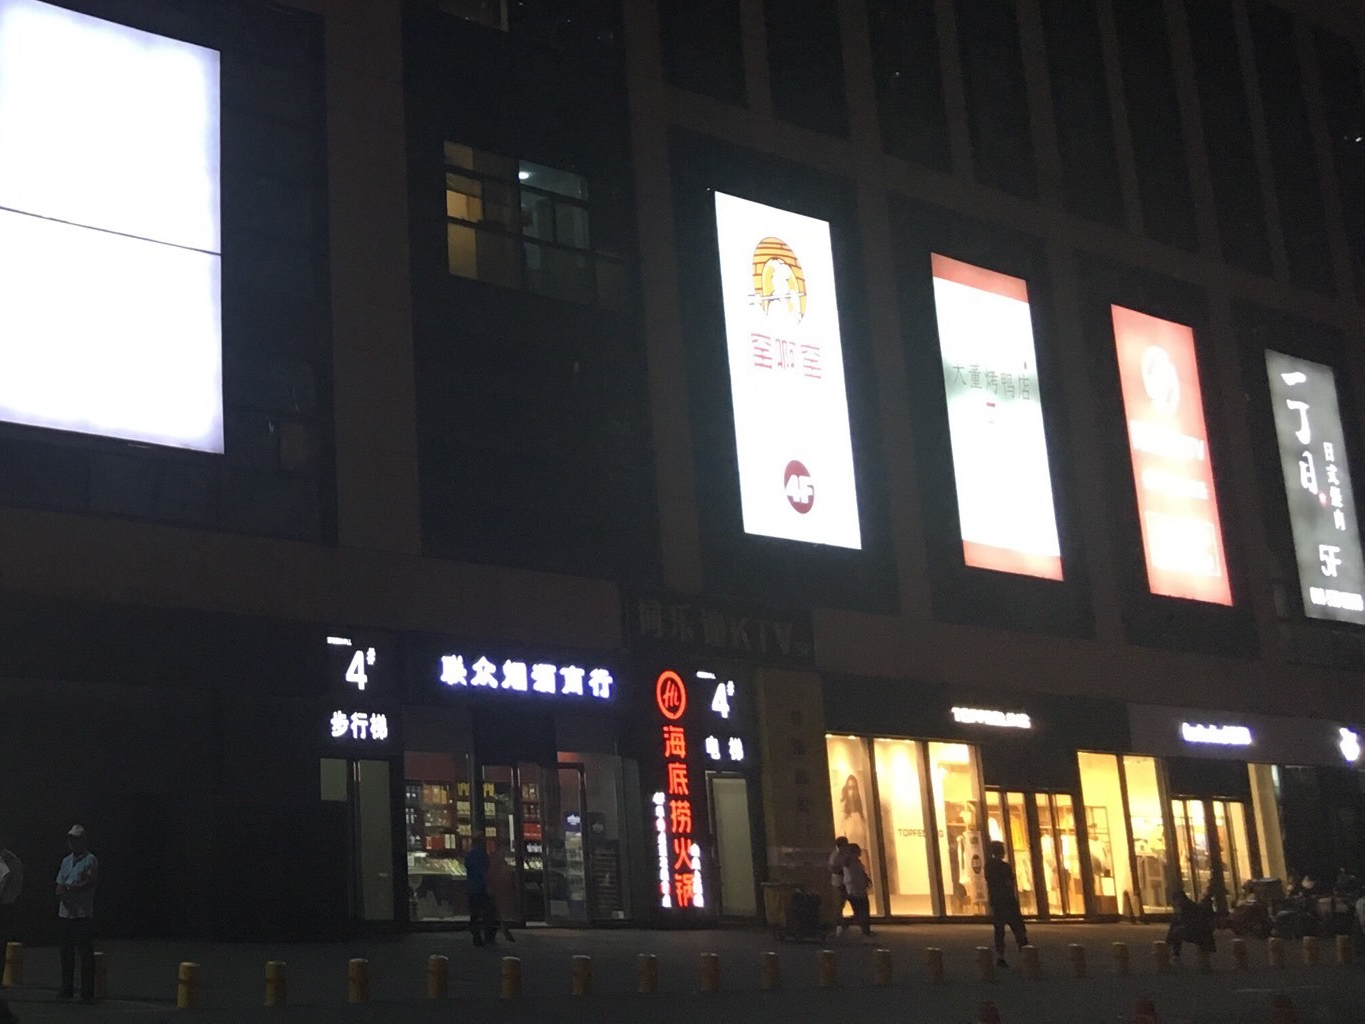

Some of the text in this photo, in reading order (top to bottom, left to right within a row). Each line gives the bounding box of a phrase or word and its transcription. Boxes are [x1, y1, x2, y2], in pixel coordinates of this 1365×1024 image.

[785, 474, 814, 504] 4F
[1281, 372, 1318, 495] 一丁目
[663, 726, 694, 907] 海底捞火锅
